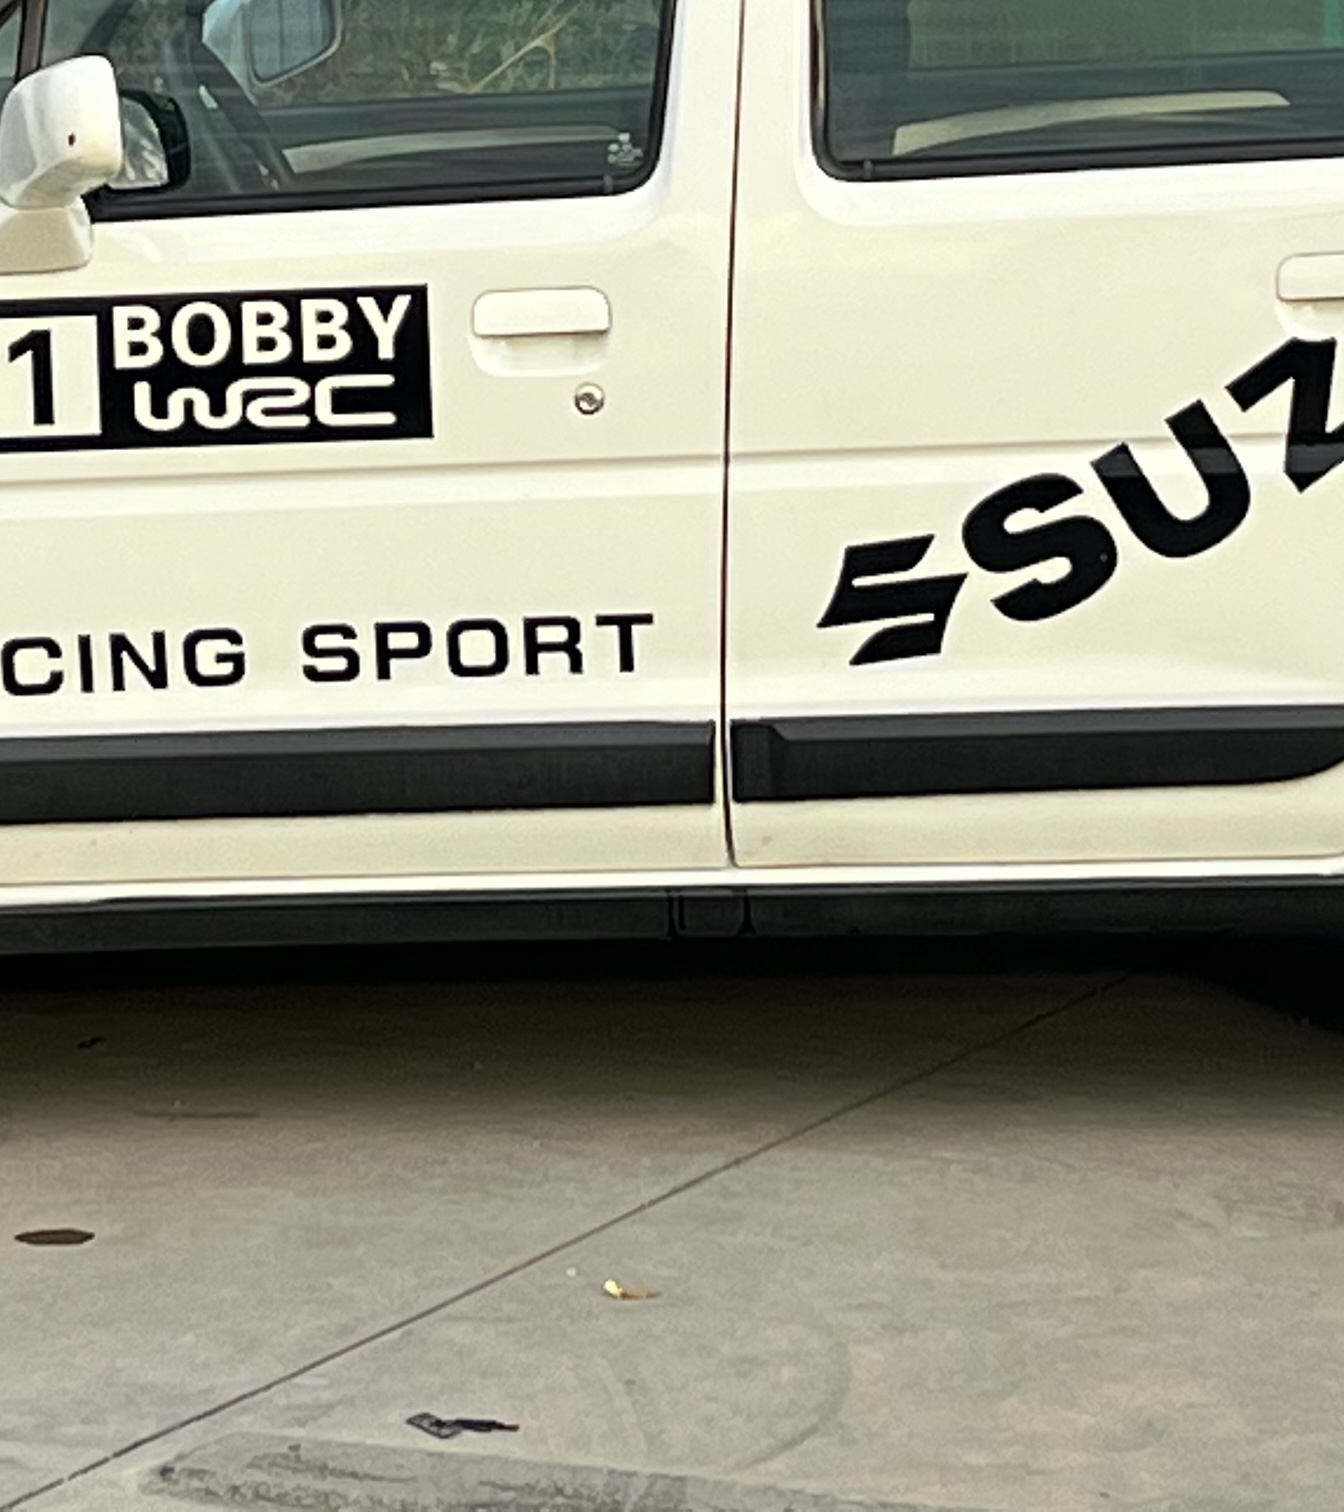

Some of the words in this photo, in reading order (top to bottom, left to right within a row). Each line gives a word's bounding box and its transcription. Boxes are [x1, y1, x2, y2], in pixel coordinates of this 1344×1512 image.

[112, 294, 413, 370] BOBBY
[7, 328, 56, 427] 1
[133, 373, 397, 432] WRC
[302, 613, 654, 683] SPORT
